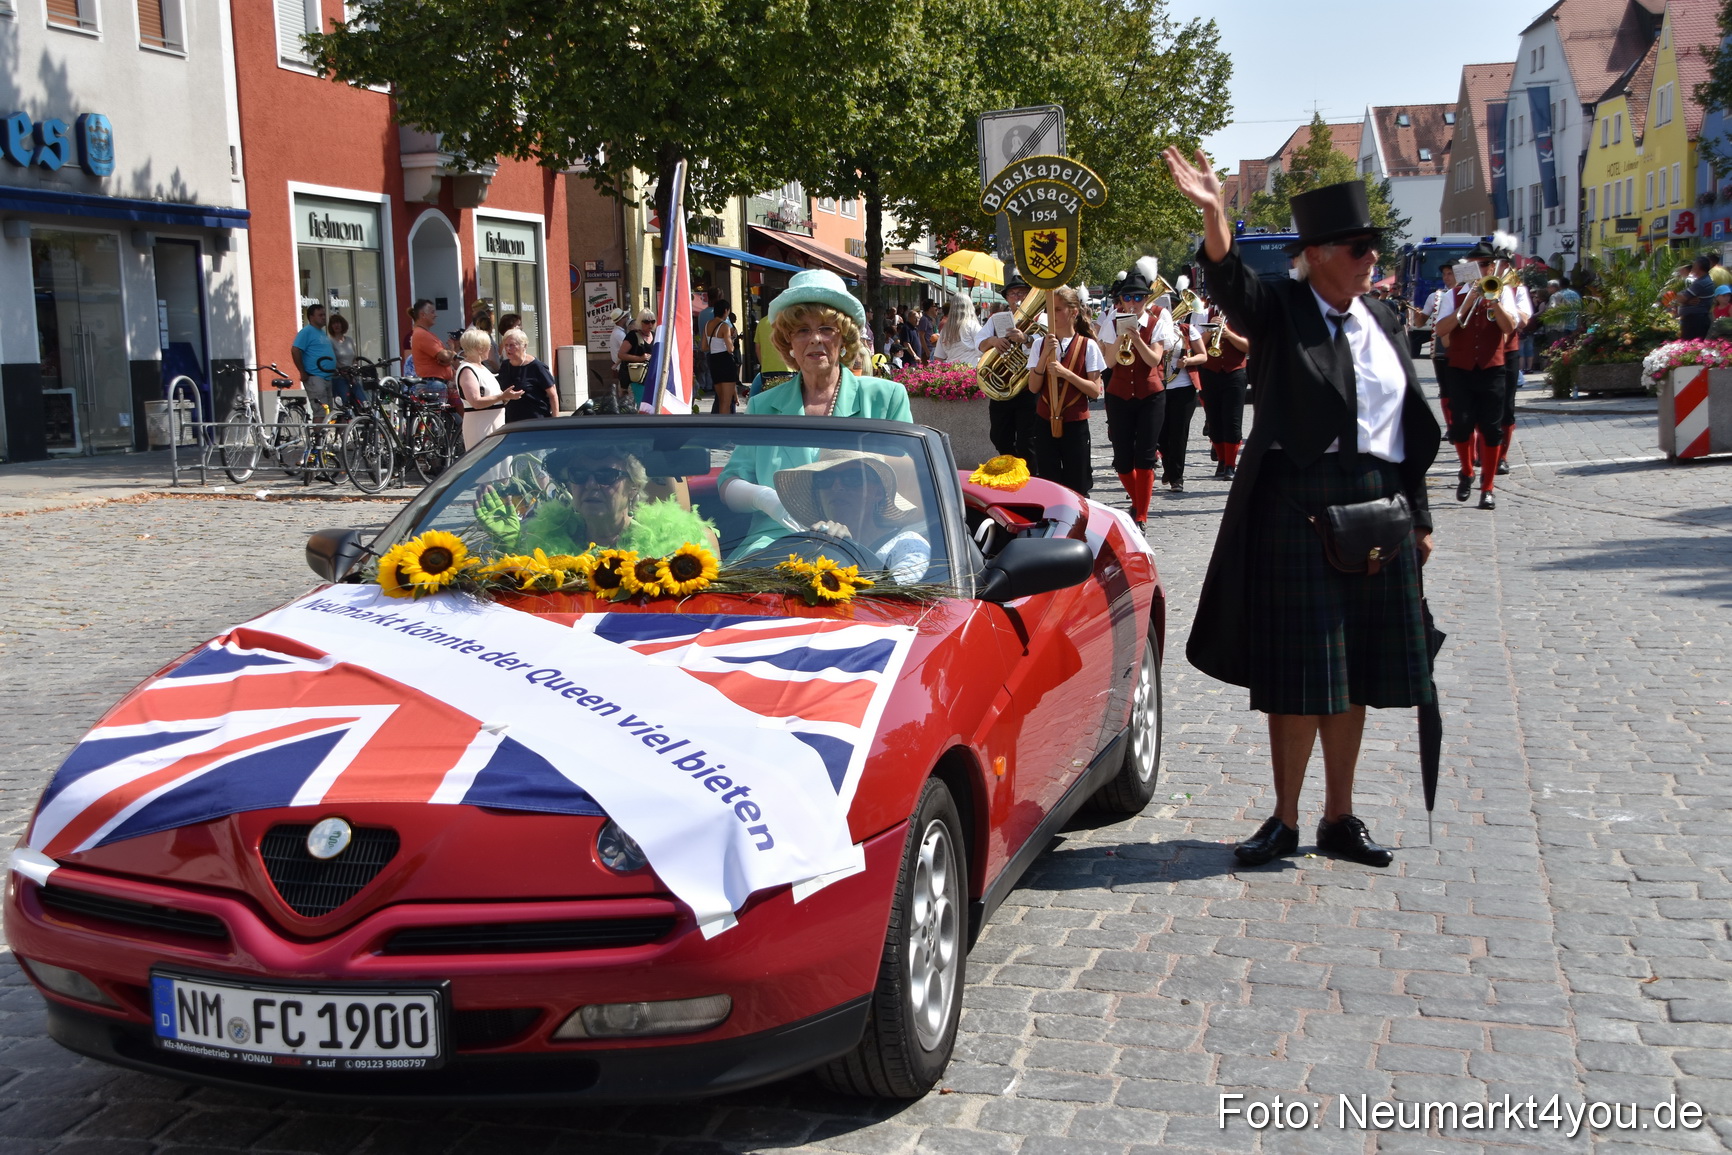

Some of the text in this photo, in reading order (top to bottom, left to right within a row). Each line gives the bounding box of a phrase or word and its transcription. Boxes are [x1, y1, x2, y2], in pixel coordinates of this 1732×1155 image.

[0, 112, 70, 171] es
[1607, 162, 1621, 177] HOTEL
[982, 163, 1098, 210] Blaskapelle
[1005, 187, 1078, 216] Pilsach
[1031, 210, 1058, 222] 1954
[587, 303, 618, 318] VENEZIA
[297, 598, 775, 851] Neumarkt könnte der Queen viel bieten
[162, 1013, 170, 1026] D
[177, 987, 429, 1049] NM FC 1900
[163, 1040, 230, 1058] Kfz-Meisterbetrieb
[241, 1053, 272, 1064] VONAU
[317, 1059, 337, 1068] Lauf
[355, 1060, 384, 1068] 09123
[386, 1059, 426, 1068] 9808797
